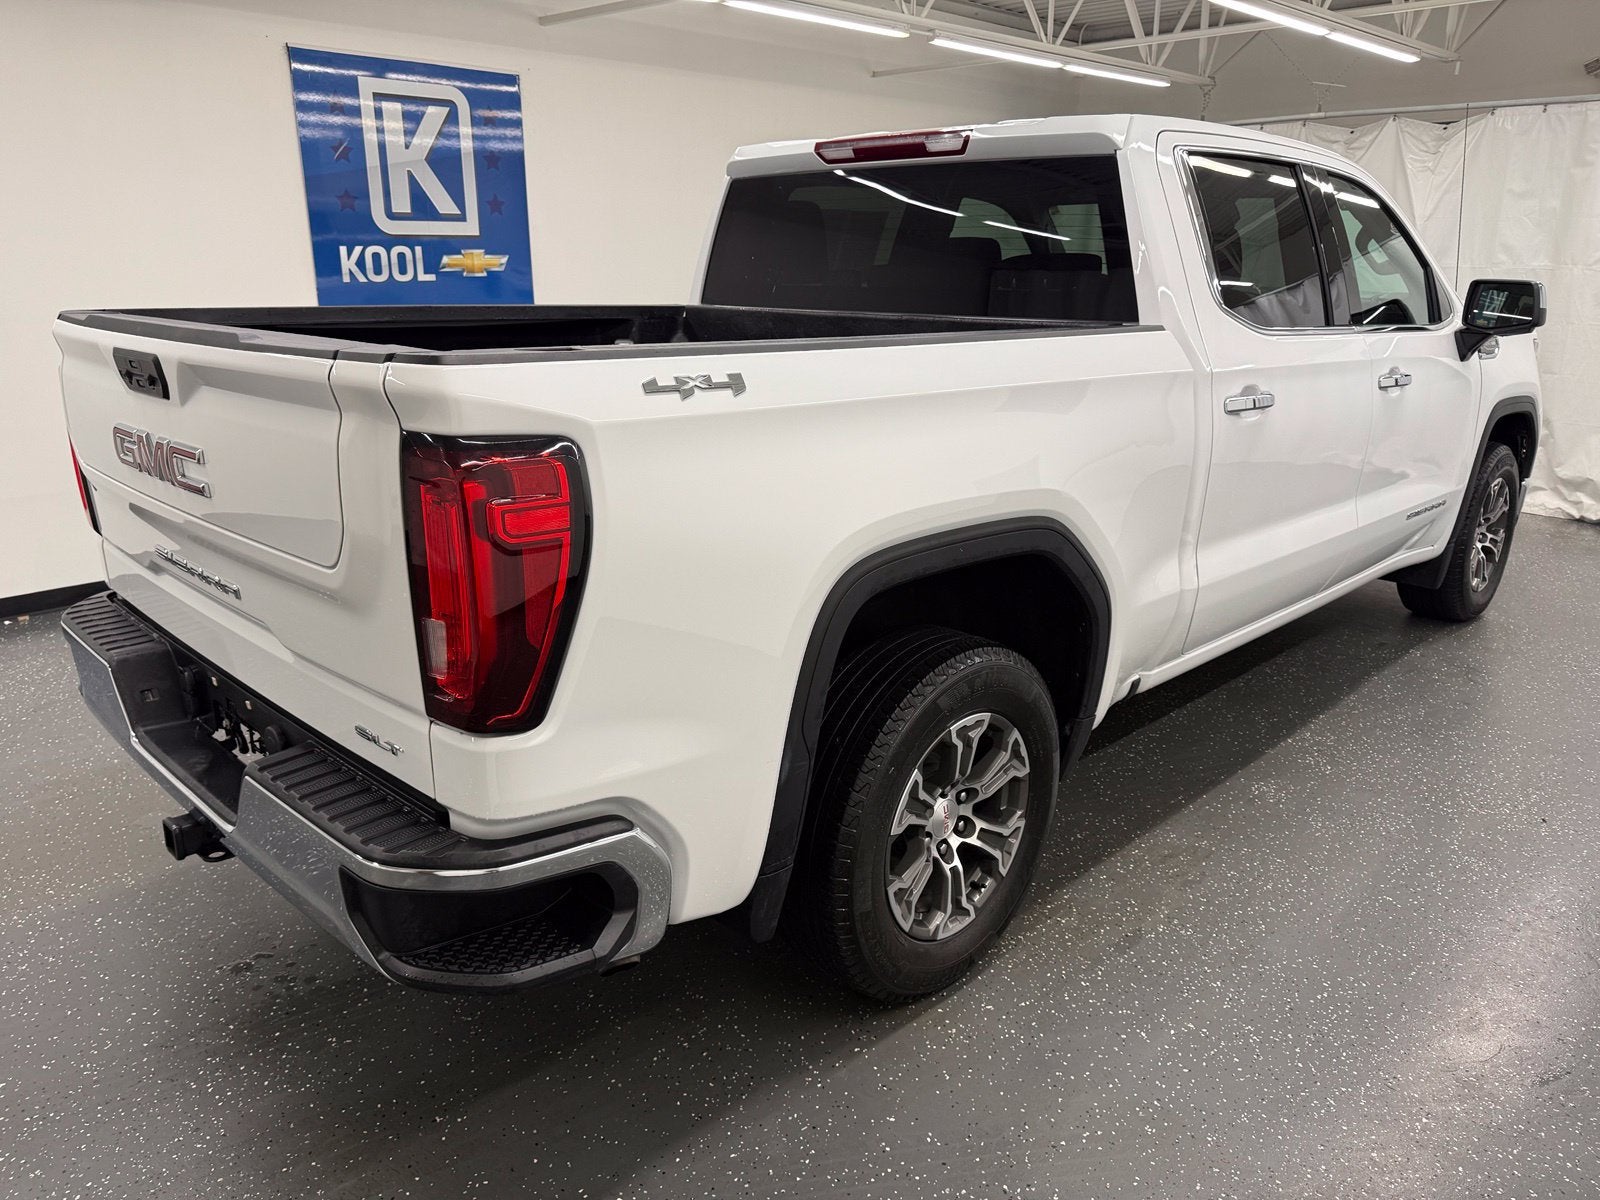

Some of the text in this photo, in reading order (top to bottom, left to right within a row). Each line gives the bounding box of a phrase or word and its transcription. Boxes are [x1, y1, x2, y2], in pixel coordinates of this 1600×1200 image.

[381, 101, 462, 214] K
[339, 245, 437, 283] KOOL
[112, 422, 212, 499] GMC
[354, 724, 404, 757] SLT
